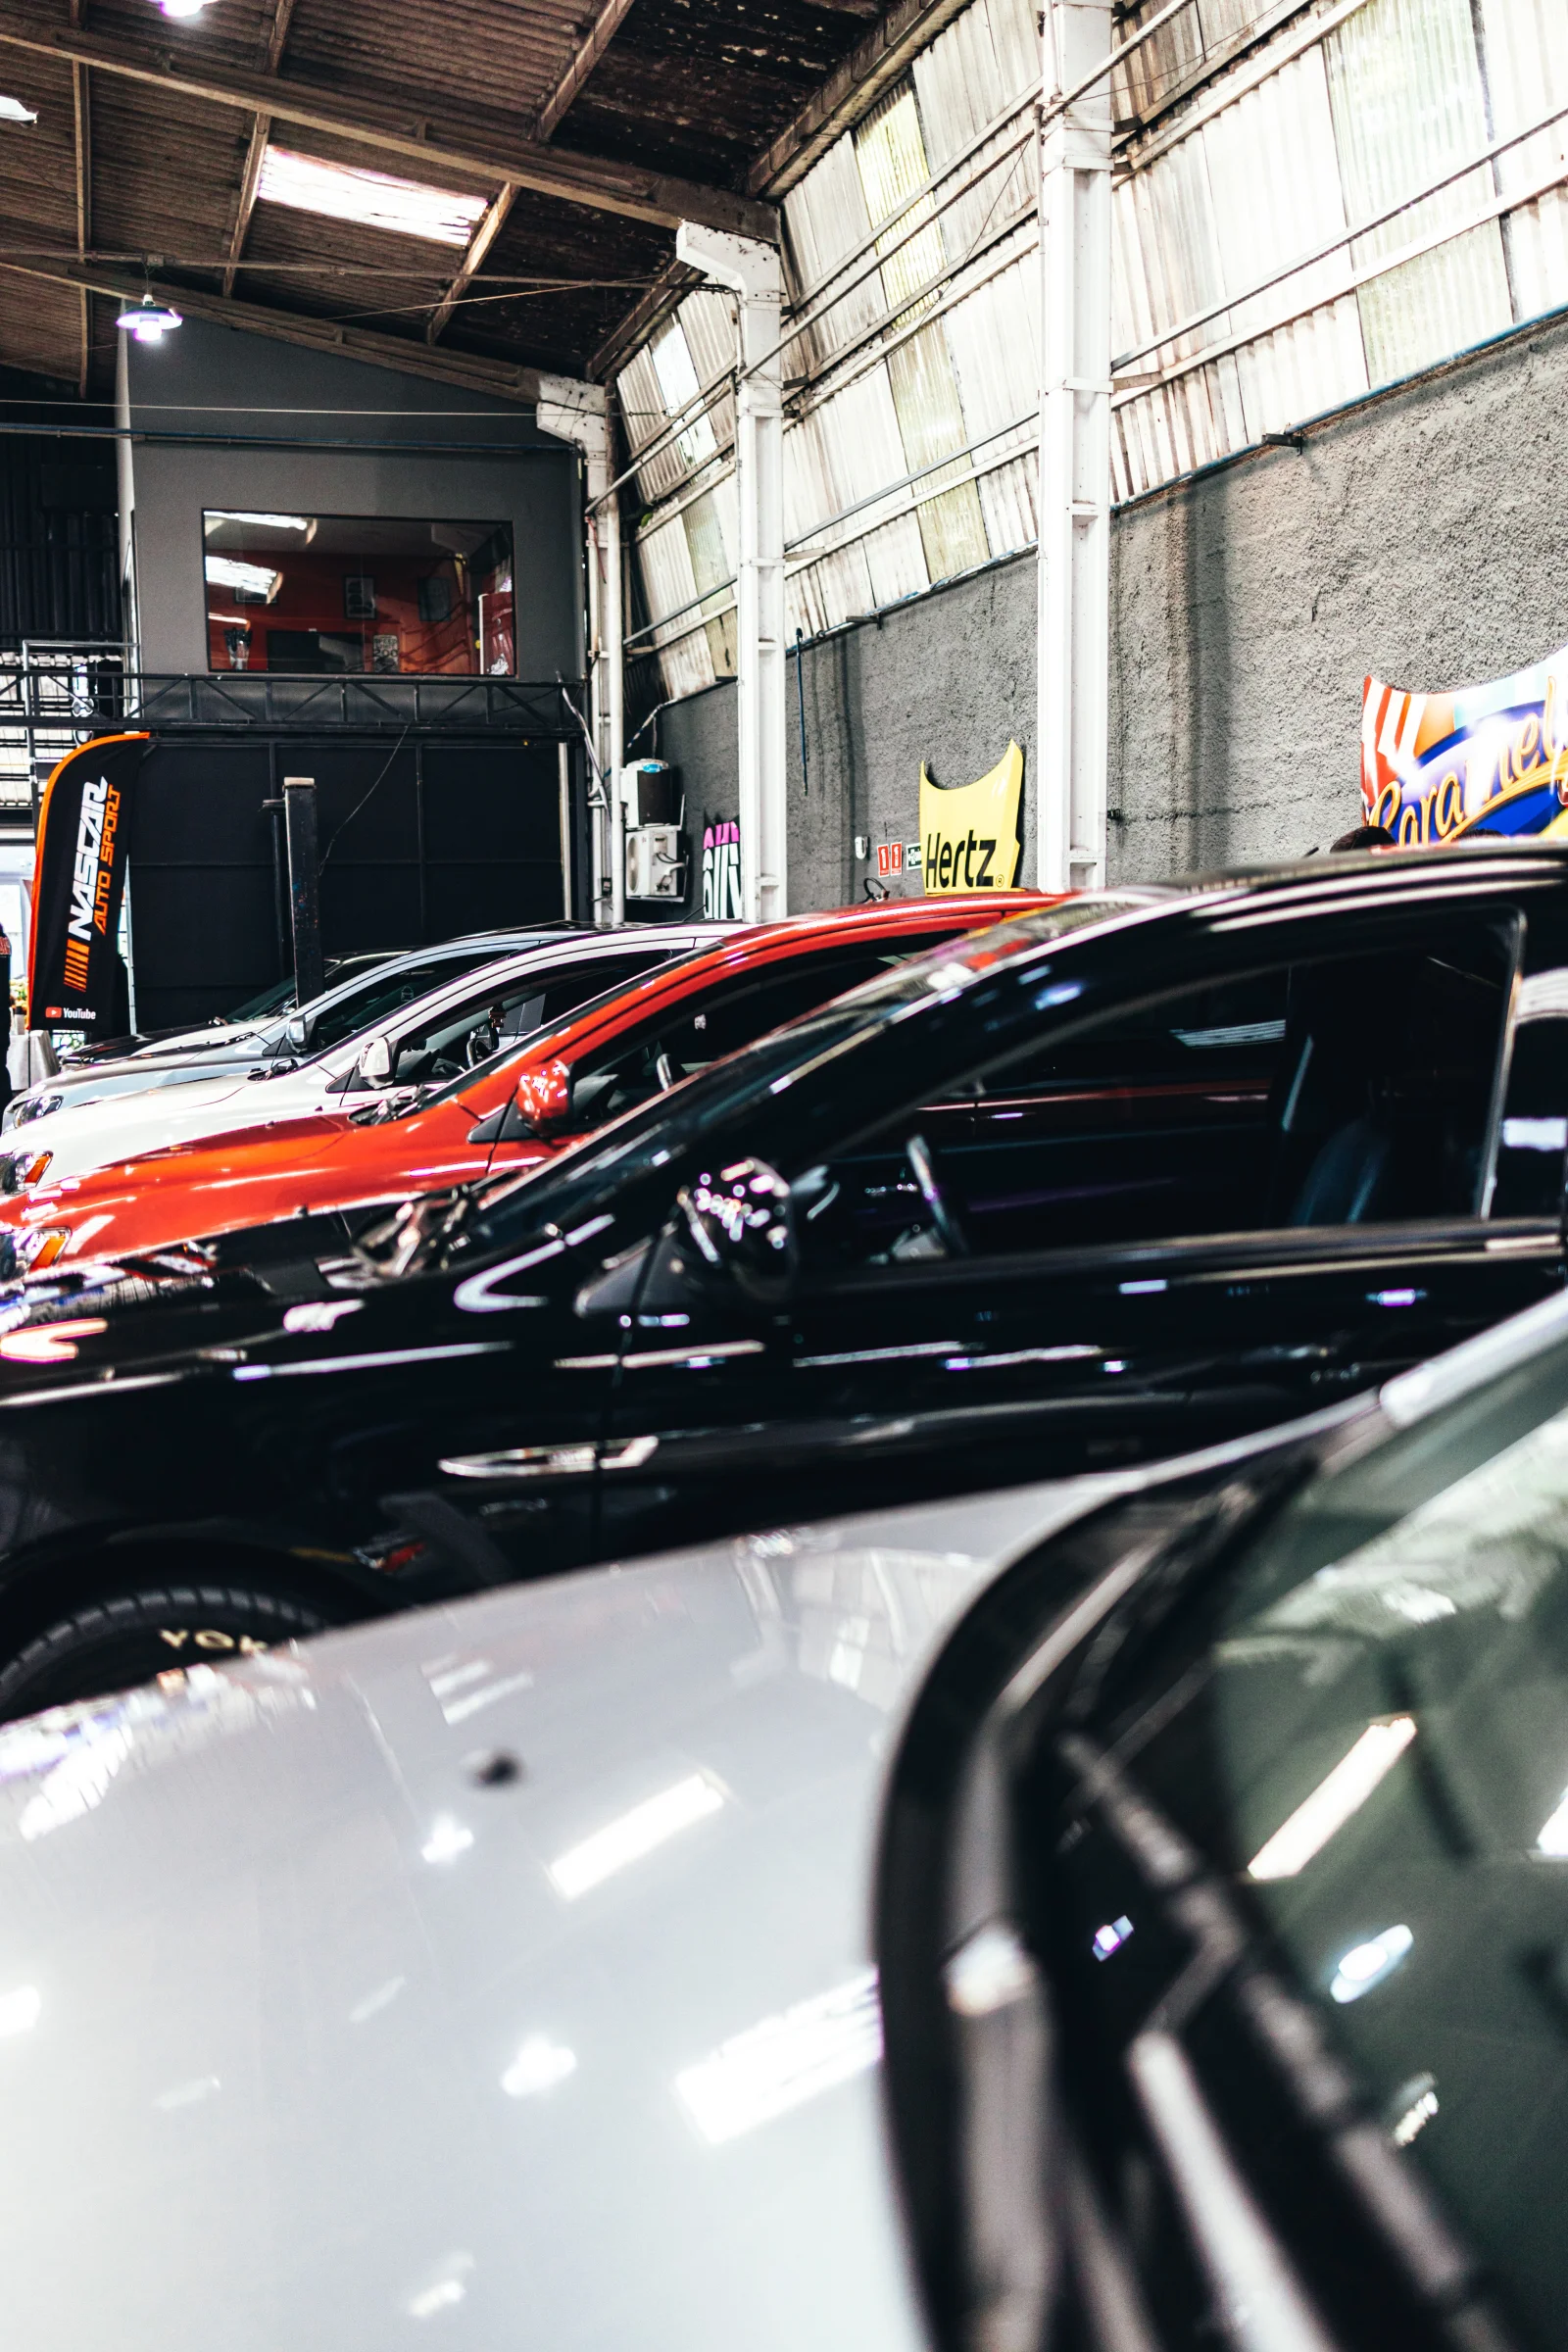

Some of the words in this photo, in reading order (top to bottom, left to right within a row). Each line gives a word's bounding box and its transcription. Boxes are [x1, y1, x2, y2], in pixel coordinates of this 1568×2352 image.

[100, 783, 121, 866] SPORT
[68, 776, 108, 941] NASCAR
[926, 830, 997, 889] Hertz
[94, 870, 112, 935] AUTO
[63, 1007, 97, 1020] YouTube
